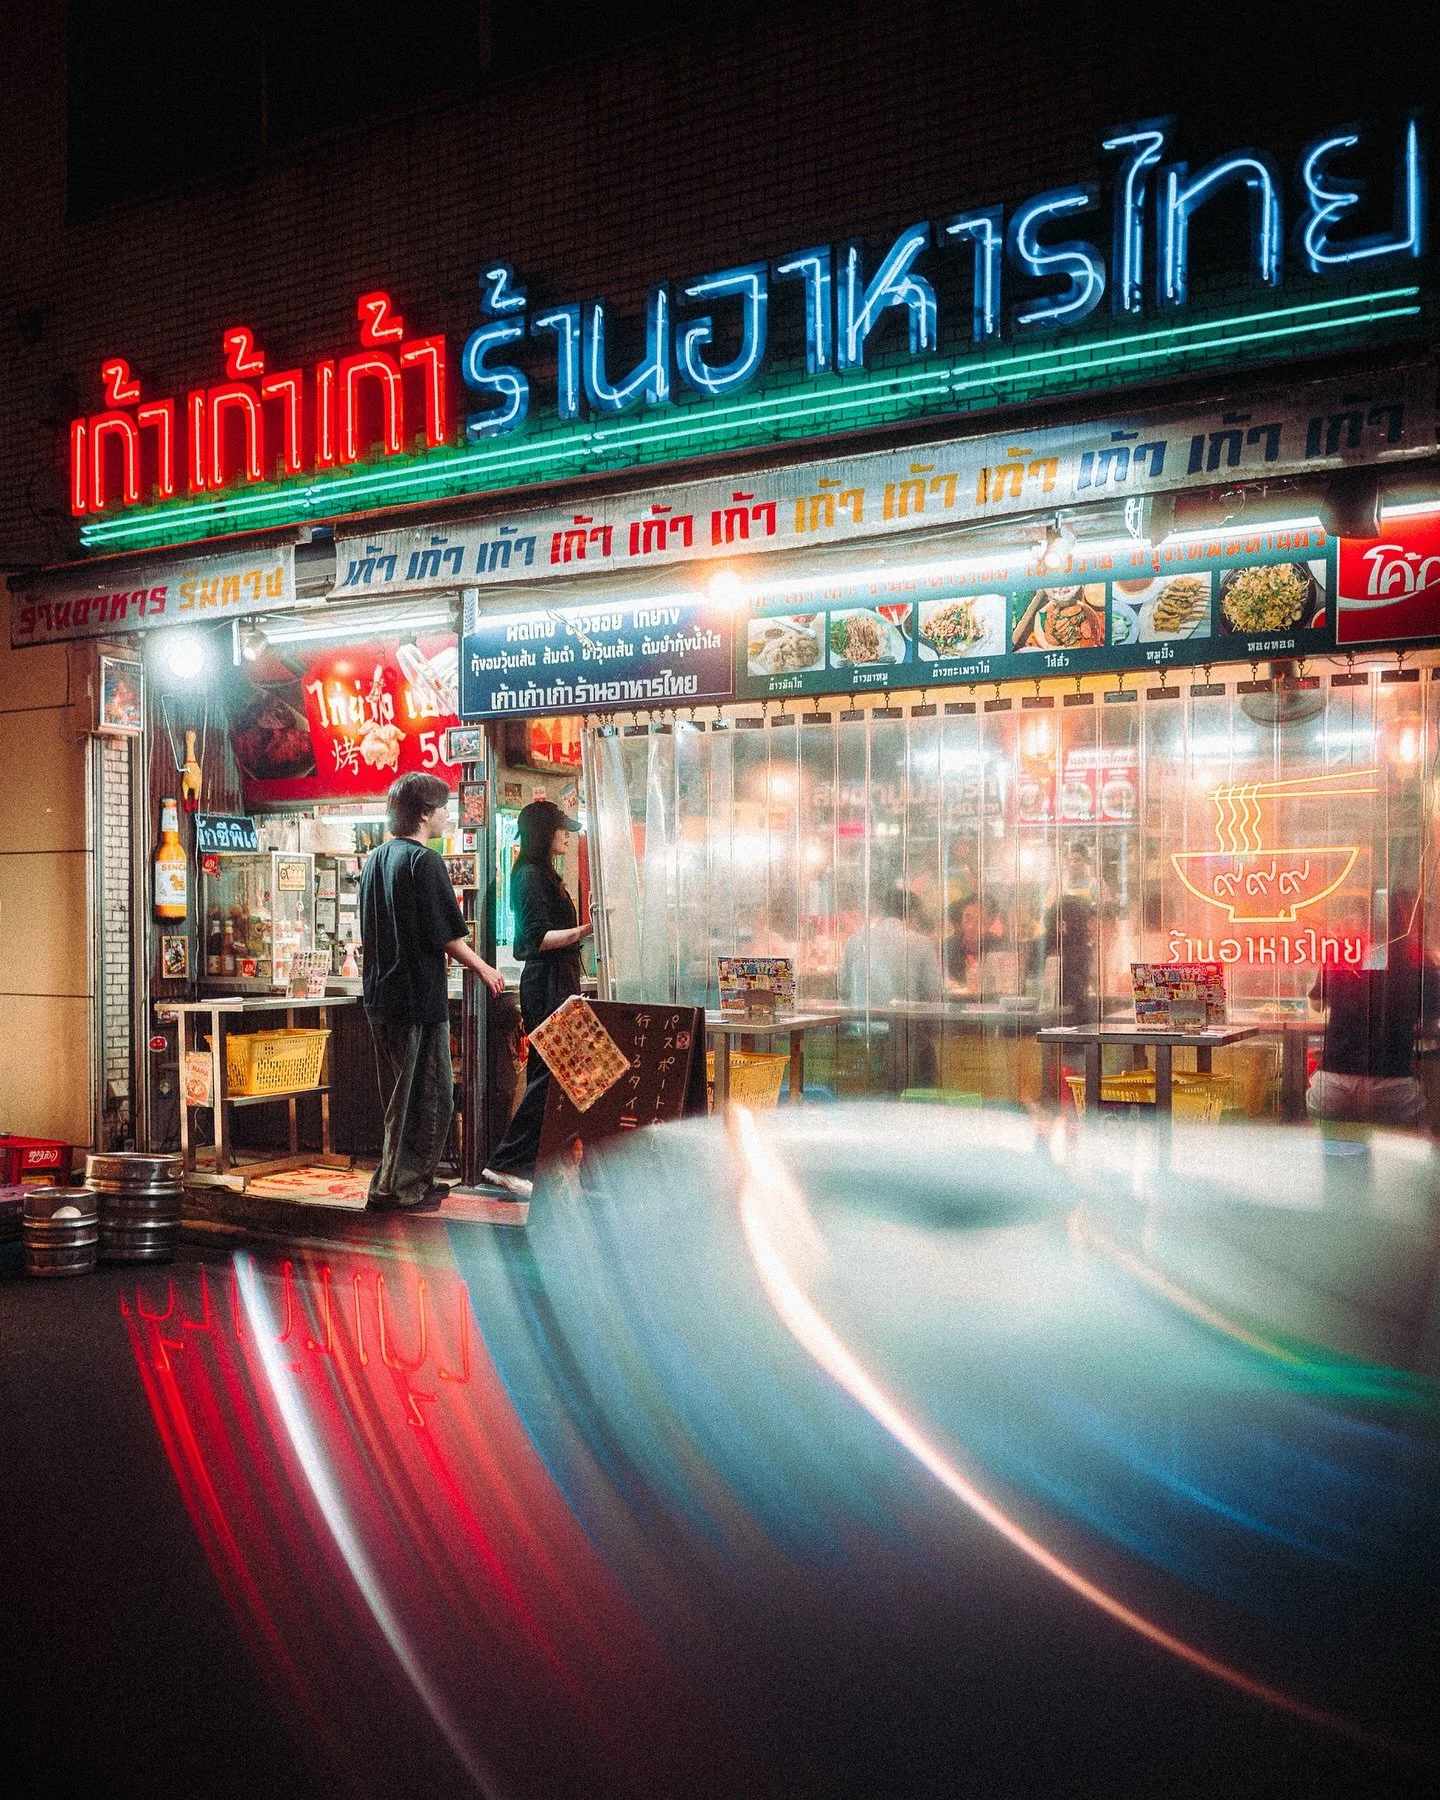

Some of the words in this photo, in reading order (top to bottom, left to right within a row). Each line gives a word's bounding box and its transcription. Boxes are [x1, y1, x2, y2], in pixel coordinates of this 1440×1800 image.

[344, 546, 397, 586] เก้า
[407, 536, 466, 581] เก้า
[476, 526, 535, 575] เก้า
[550, 515, 612, 565] เก้า
[629, 504, 693, 555] เก้า
[711, 491, 778, 545] เก้า
[794, 478, 864, 531] เก้า
[883, 463, 956, 521] เก้า
[976, 446, 1059, 505] เก้า
[1077, 431, 1168, 490] เก้า
[1187, 415, 1282, 474] เก้า
[1167, 929, 1362, 964] ร้านอาหารไทย
